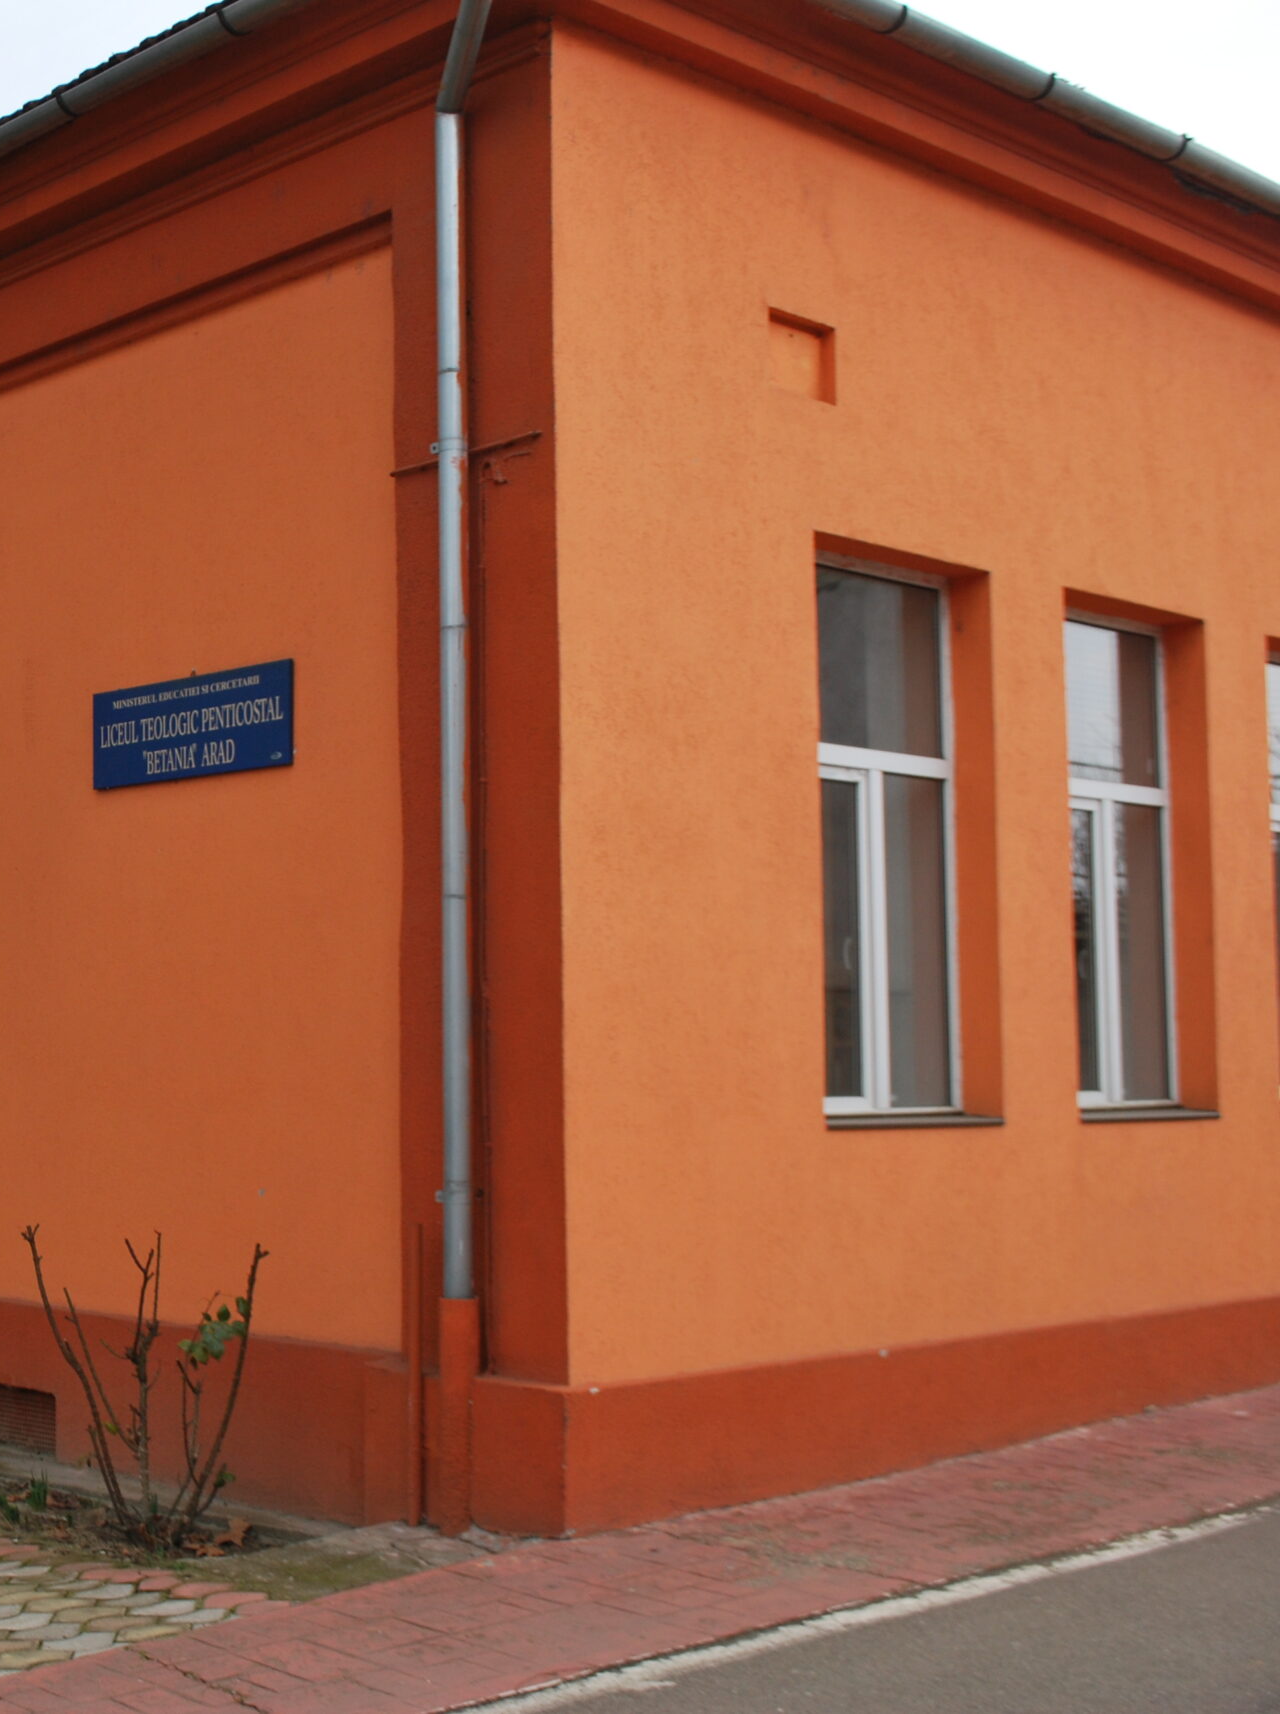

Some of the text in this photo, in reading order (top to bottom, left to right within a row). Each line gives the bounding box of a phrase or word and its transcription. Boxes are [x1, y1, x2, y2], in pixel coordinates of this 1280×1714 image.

[113, 694, 157, 710] MINISTERUL
[159, 686, 199, 701] EDUCATIEI
[100, 696, 283, 748] LICEUL TEOLOGIC PENTICOSTAL
[143, 739, 235, 774] "BETANIA" ARAD
